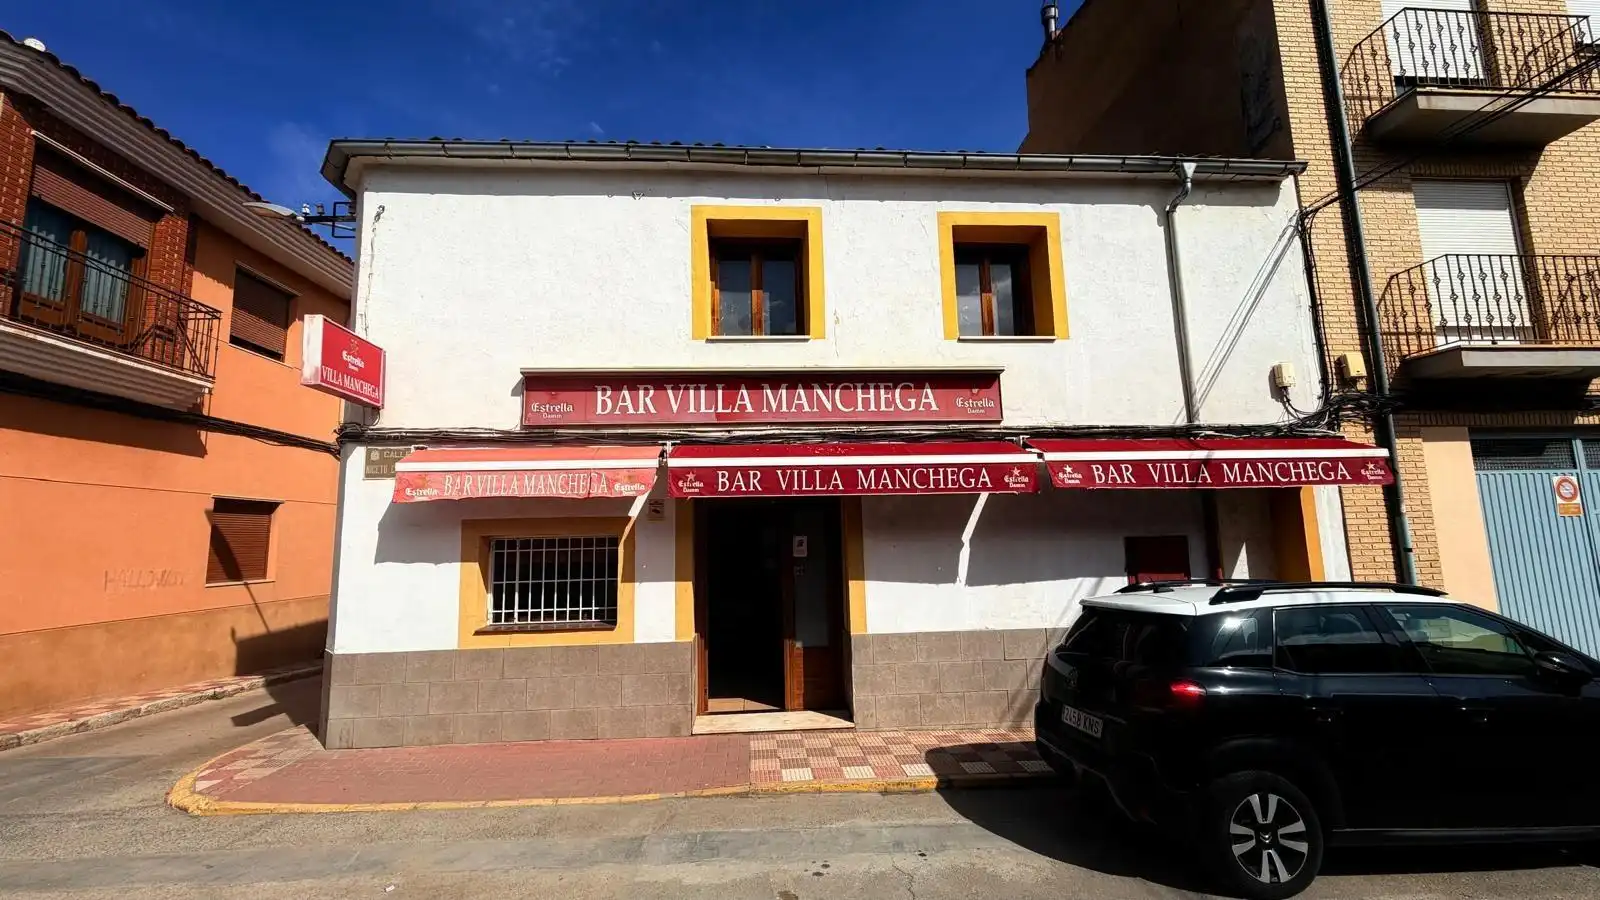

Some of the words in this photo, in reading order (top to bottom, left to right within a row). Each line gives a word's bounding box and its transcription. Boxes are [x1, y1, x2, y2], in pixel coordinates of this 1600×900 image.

[342, 350, 364, 369] Estrella
[321, 365, 343, 387] VILLA
[343, 374, 379, 400] MANCHEGA
[594, 385, 657, 415] BAR
[664, 384, 753, 414] VILLA
[761, 382, 939, 413] MANCHEGA
[955, 396, 995, 409] Estrella
[532, 401, 574, 413] Estrella
[716, 471, 762, 492] BAR
[776, 470, 845, 491] VILLA
[856, 468, 993, 490] MANCHEGA
[1004, 475, 1029, 484] Estrella
[1058, 472, 1083, 480] Estrella
[1091, 464, 1136, 484] BAR
[1146, 463, 1212, 483] VILLA
[1223, 461, 1352, 482] MANCHEGA
[405, 487, 438, 497] Estrella
[443, 474, 472, 496] BAR
[476, 473, 519, 496] VILLA
[522, 472, 609, 495] MANCHEGA
[613, 482, 646, 492] Estrella
[678, 480, 704, 489] Estrella
[1082, 714, 1100, 735] KNS
